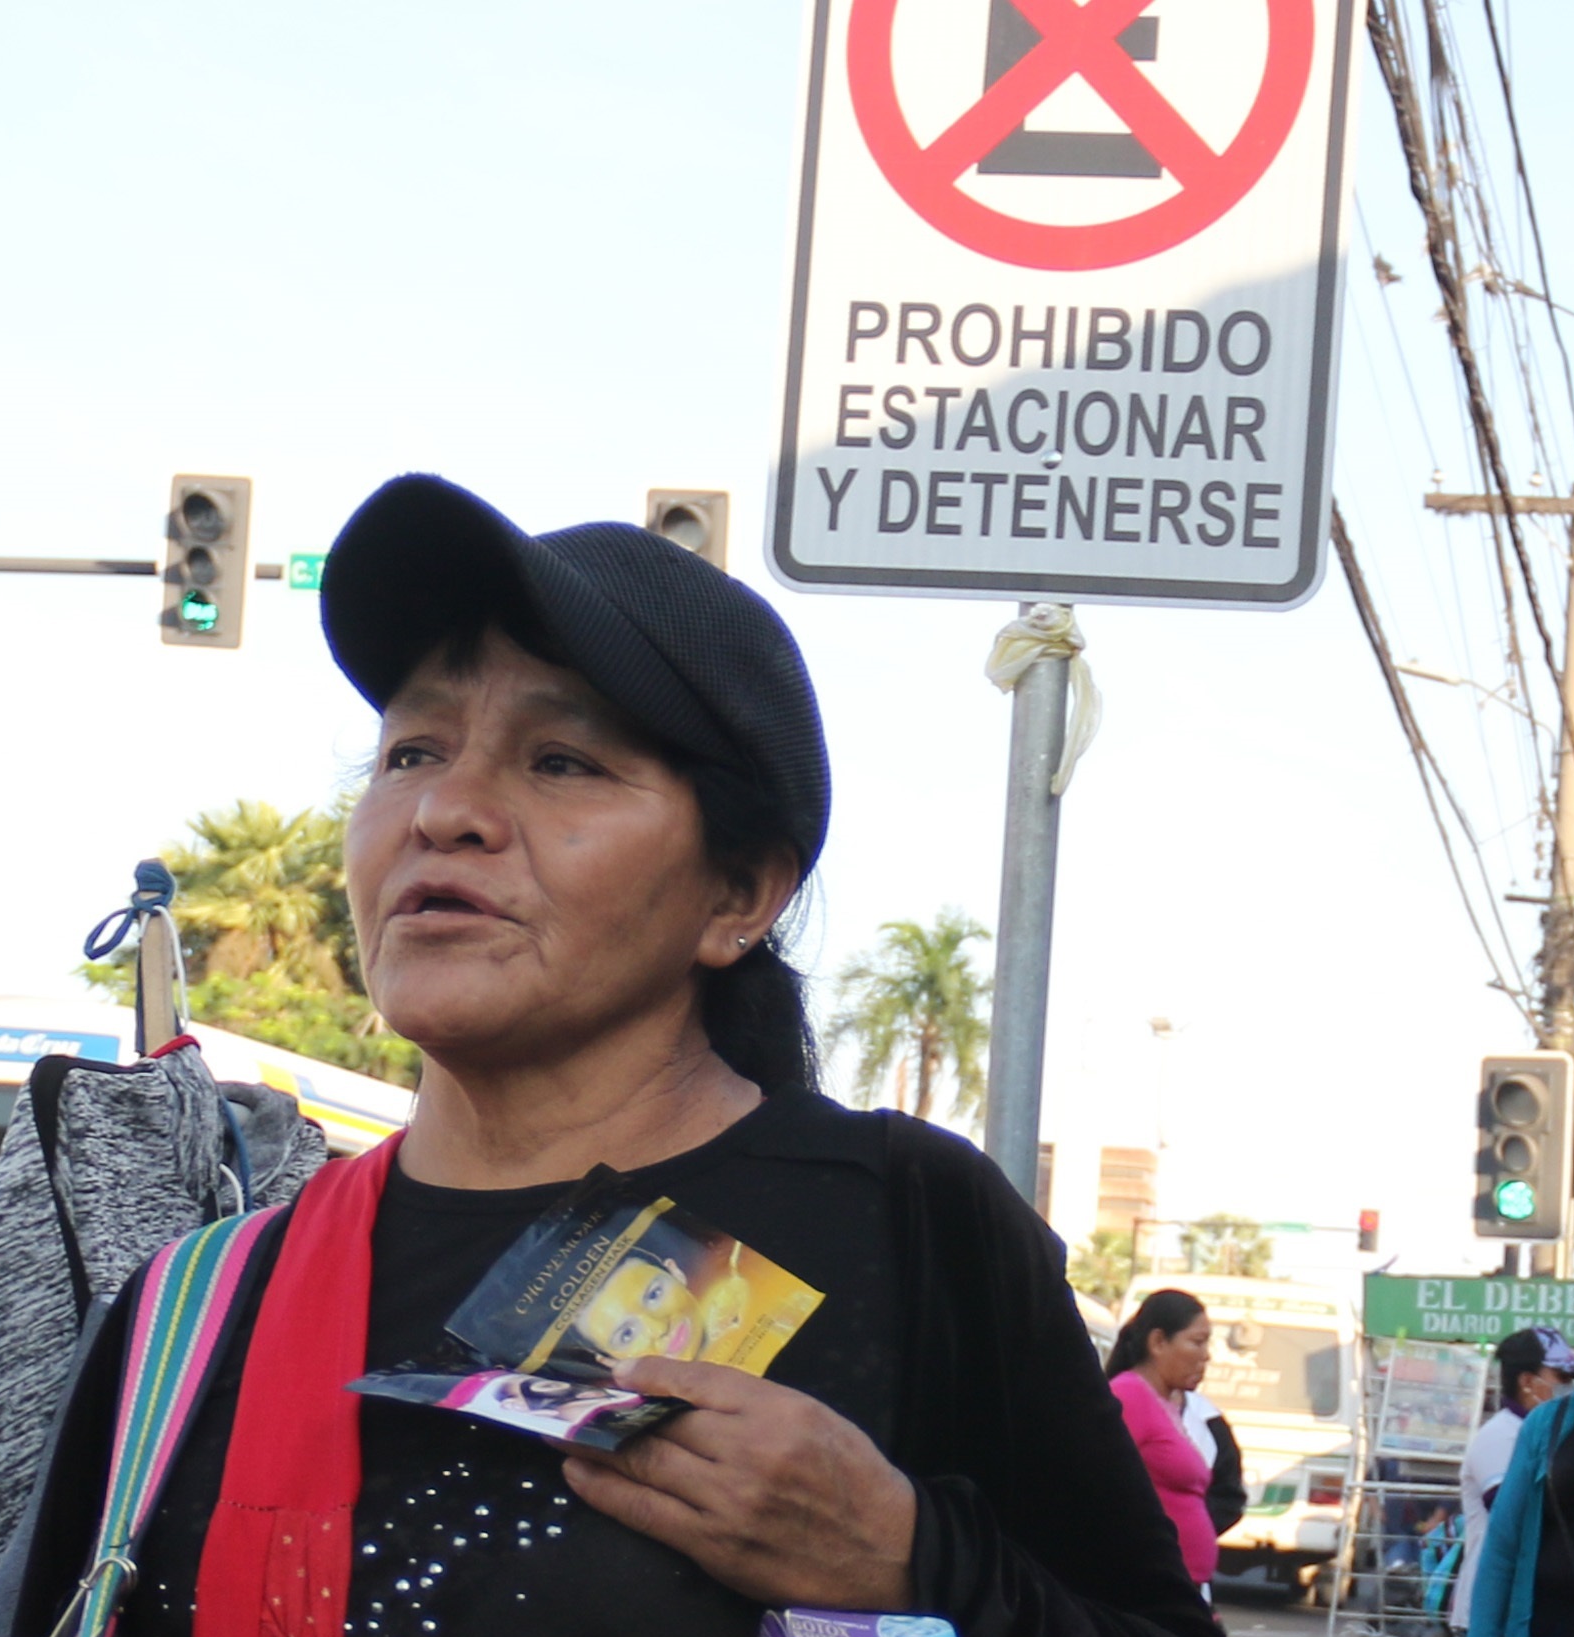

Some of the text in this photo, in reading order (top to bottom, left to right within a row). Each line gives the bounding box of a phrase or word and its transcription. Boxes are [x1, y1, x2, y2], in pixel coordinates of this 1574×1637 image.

[845, 301, 1273, 377] PROHIBIDO
[834, 384, 1267, 462] ESTACIONAR
[816, 467, 1284, 548] Y DETENERSE
[549, 1234, 612, 1311] GOLDEN
[554, 1236, 634, 1332] COLLAGEN MASK
[1416, 1279, 1467, 1311] EL
[1422, 1311, 1502, 1335] DIARIO
